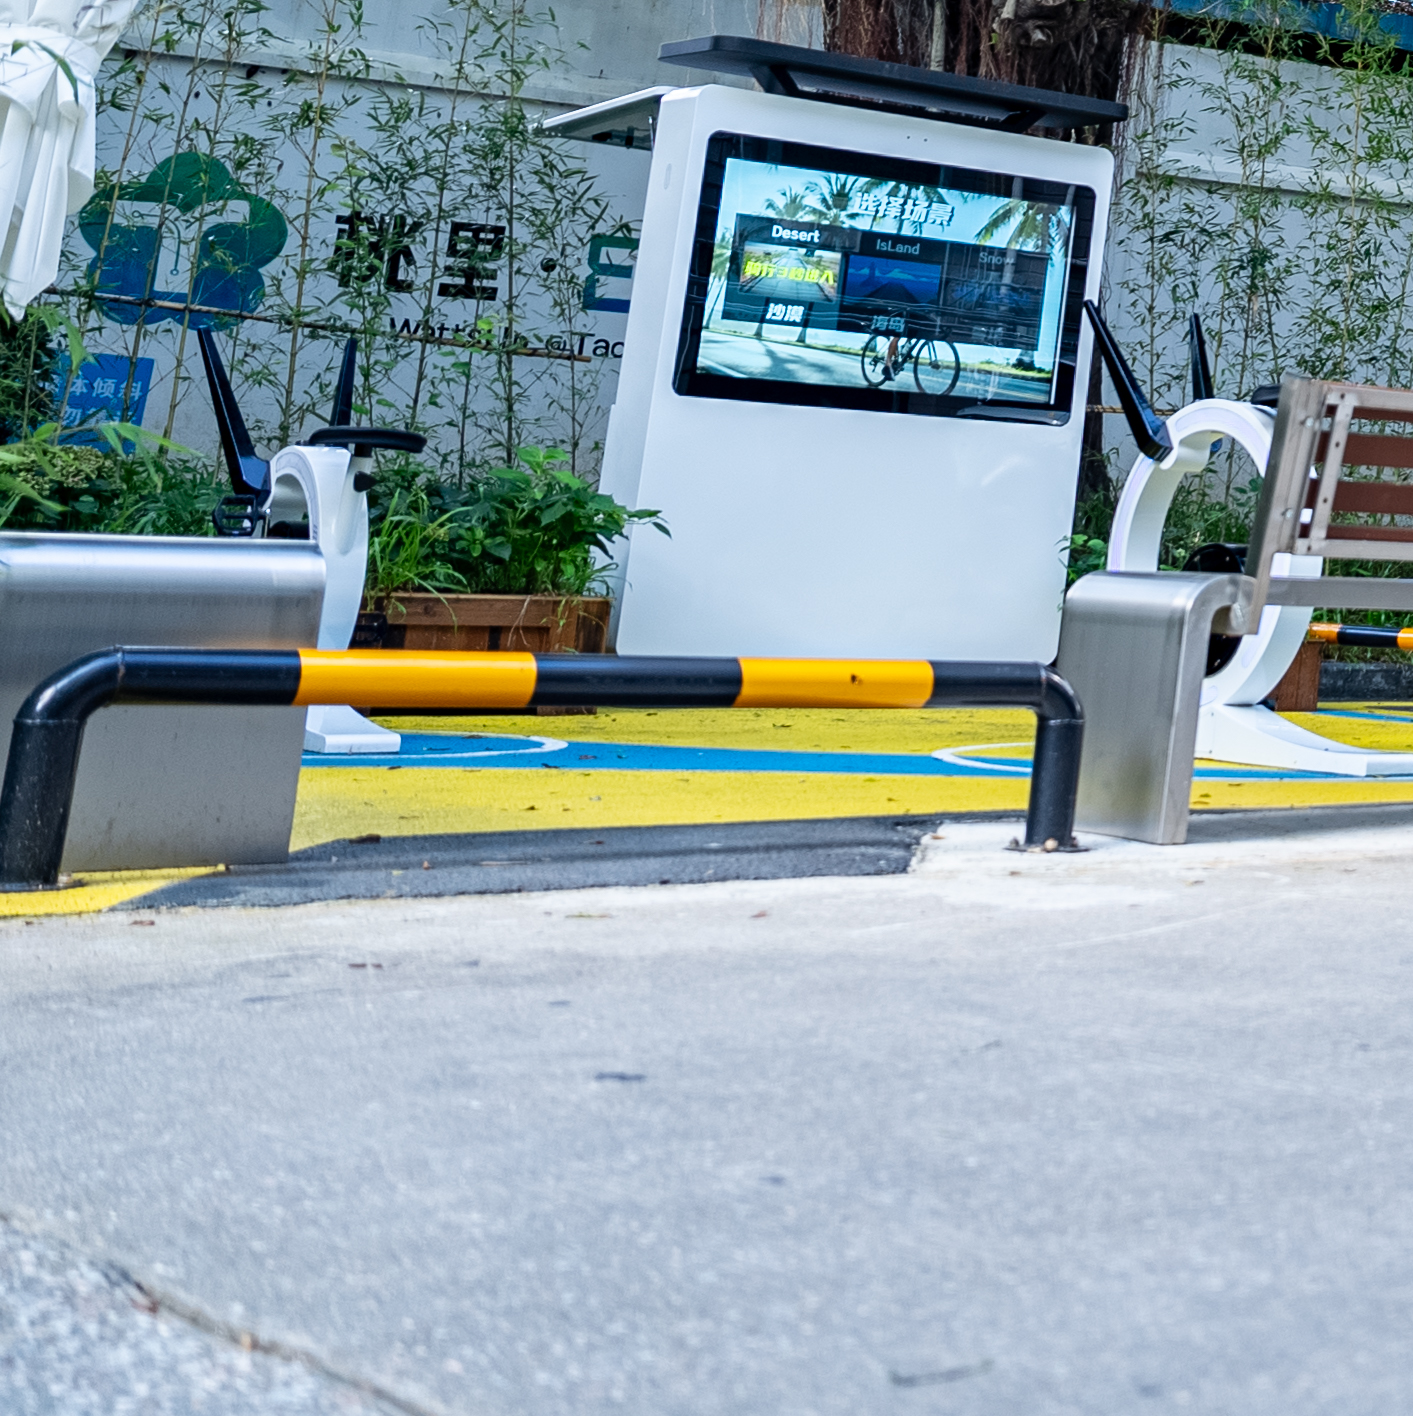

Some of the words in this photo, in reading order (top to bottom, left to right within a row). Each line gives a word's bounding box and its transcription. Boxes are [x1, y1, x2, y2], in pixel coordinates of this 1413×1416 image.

[854, 192, 954, 227] 选择场景
[771, 224, 820, 243] Desert
[876, 238, 921, 255] IsLand
[979, 251, 1016, 265] Snow
[744, 260, 835, 285] 骑行3秒进入
[765, 303, 805, 323] 沙漠
